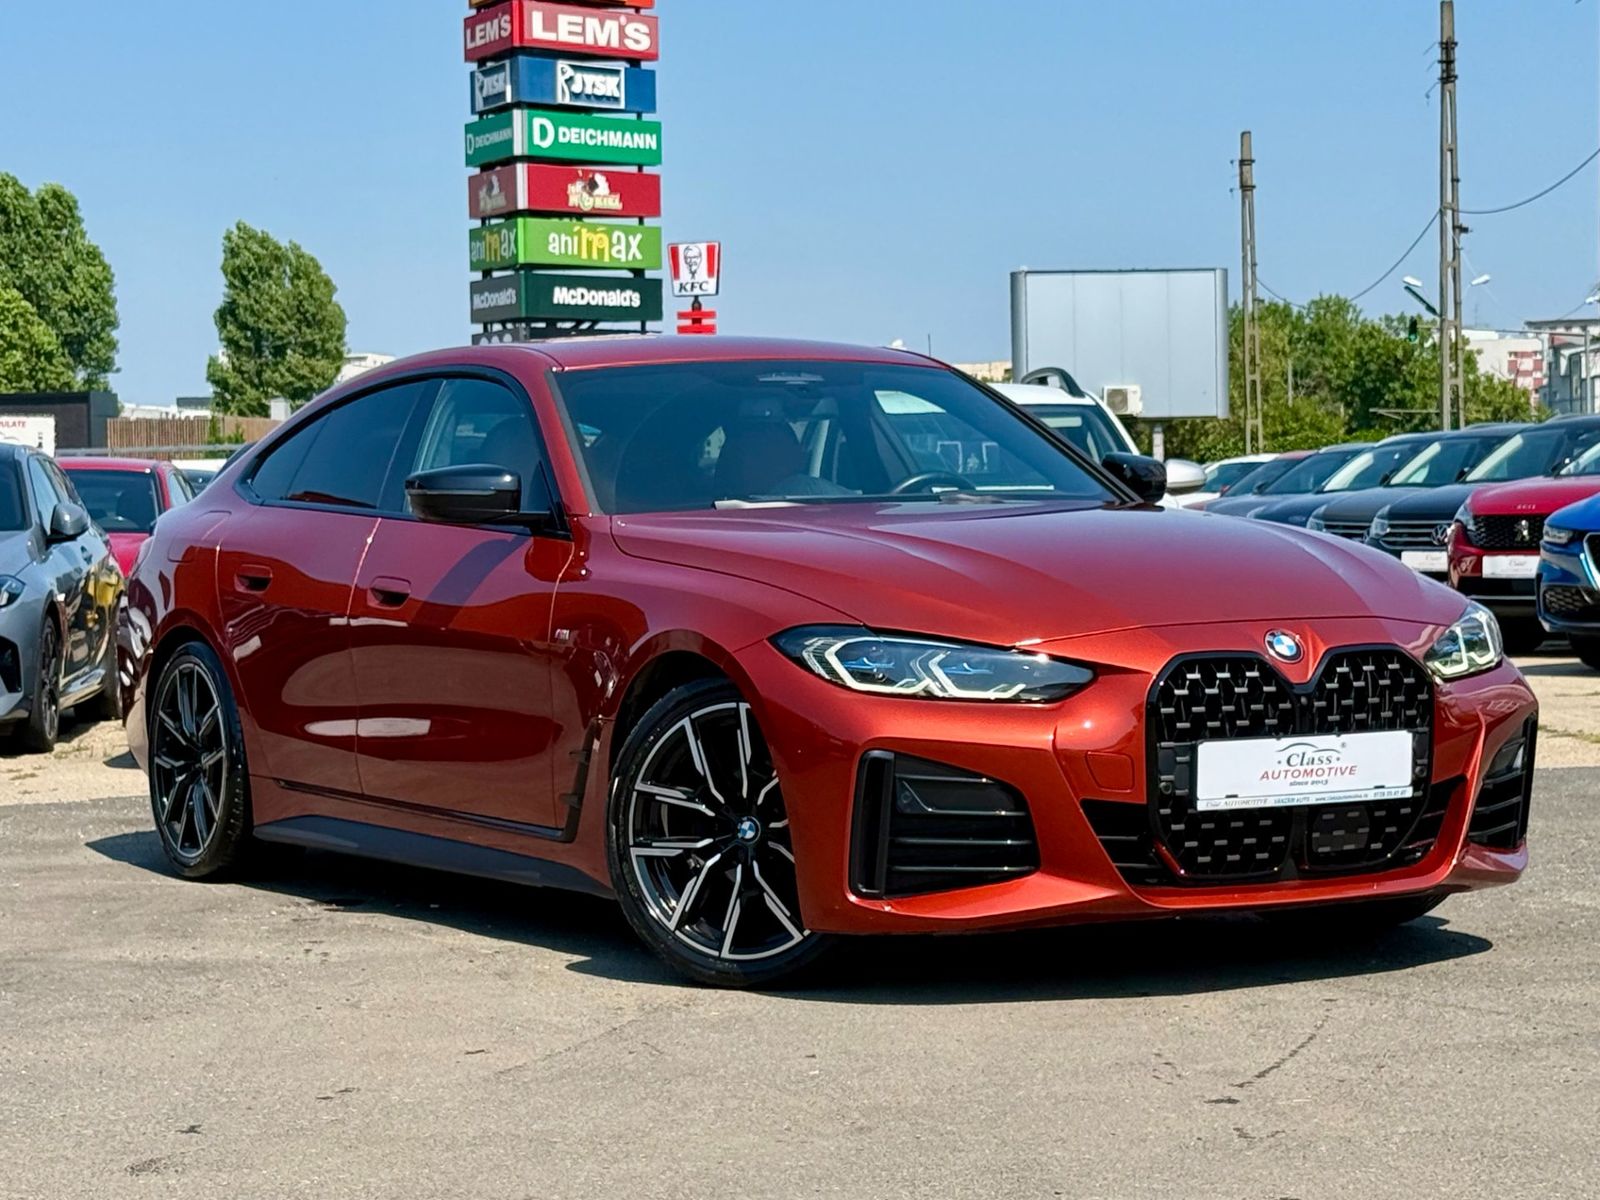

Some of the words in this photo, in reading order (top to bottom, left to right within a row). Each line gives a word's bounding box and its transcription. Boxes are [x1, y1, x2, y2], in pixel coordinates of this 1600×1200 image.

[466, 13, 511, 49] LEM'S
[532, 11, 651, 51] LEM'S
[482, 72, 506, 97] JYSK
[570, 72, 621, 98] JYSK
[475, 127, 512, 148] DEICHMANN
[558, 127, 658, 150] DEICHMANN
[471, 228, 516, 262] animax
[548, 226, 643, 262] animax
[473, 288, 517, 309] McDonald's
[553, 286, 640, 308] McDonald's
[678, 281, 710, 294] KFC
[1286, 752, 1332, 768] Class
[1260, 765, 1358, 782] AUTOMOTIVE
